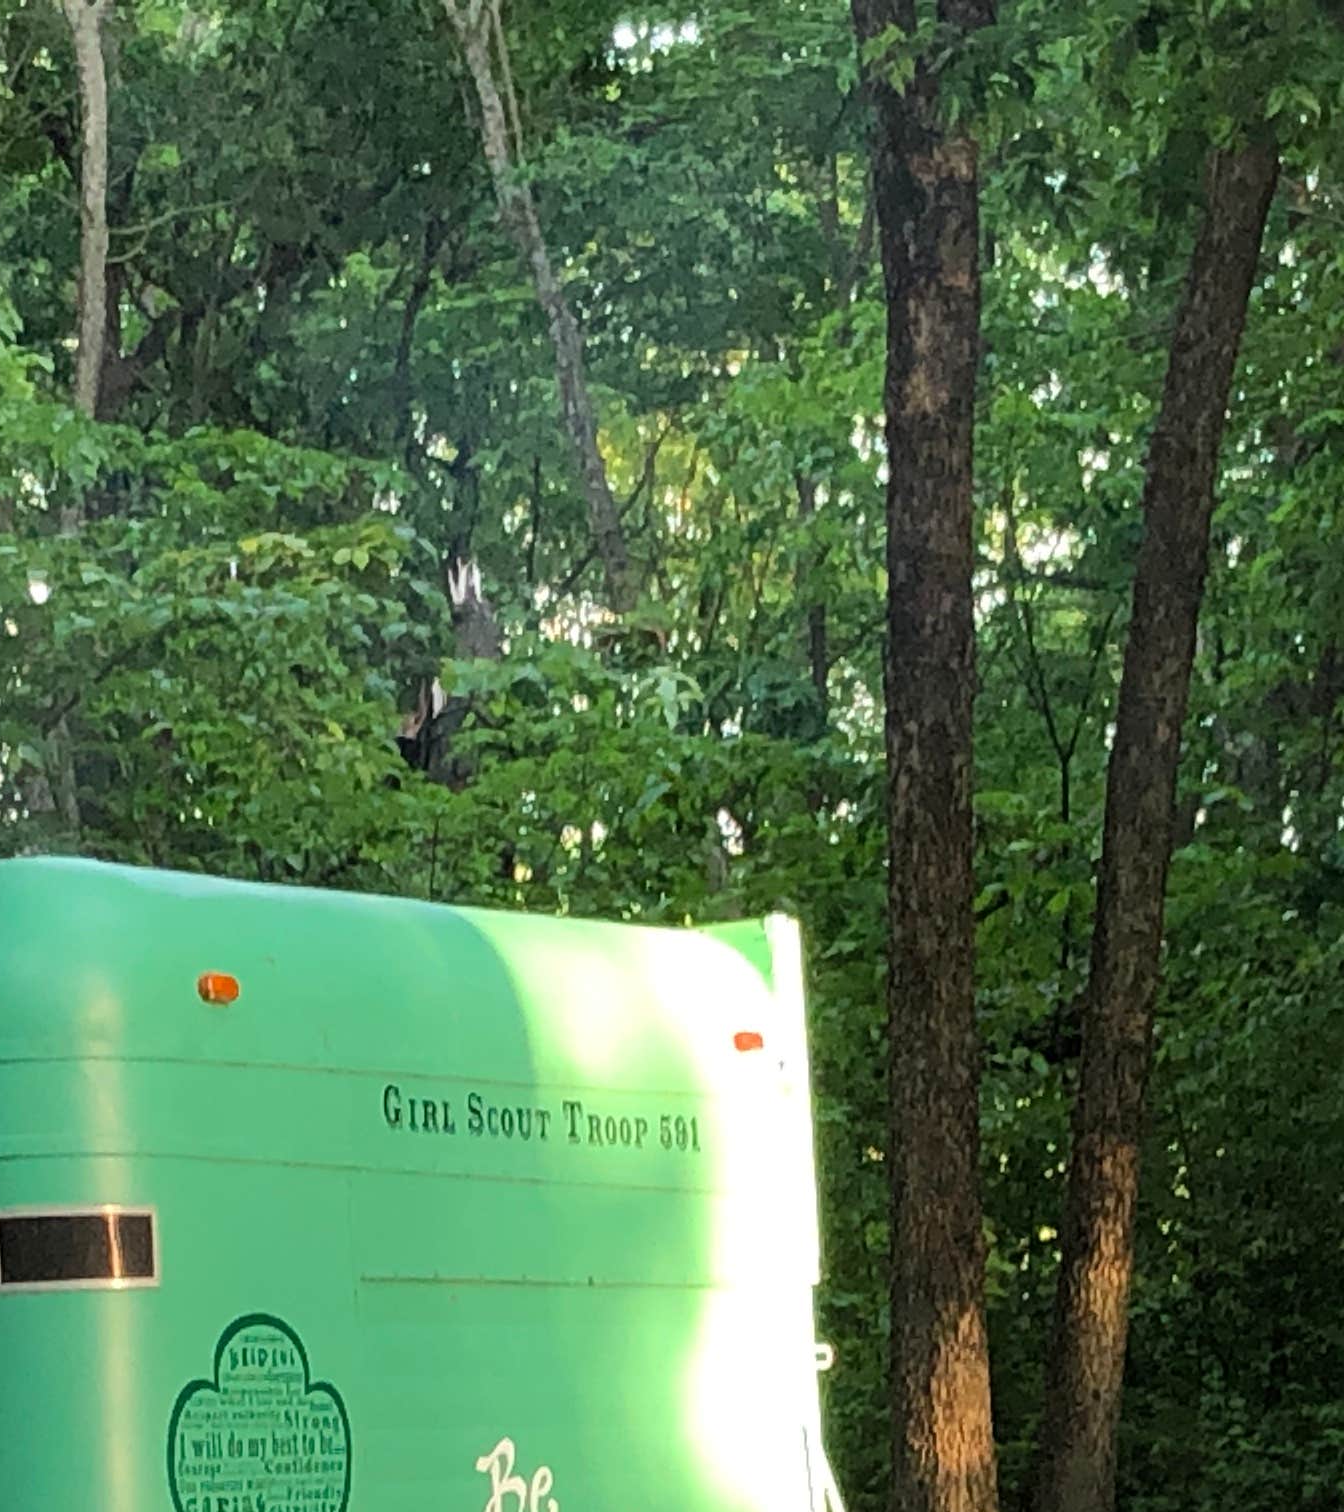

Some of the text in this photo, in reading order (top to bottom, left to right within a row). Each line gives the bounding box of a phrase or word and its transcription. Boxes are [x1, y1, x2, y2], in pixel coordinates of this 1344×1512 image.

[192, 1431, 223, 1454] will
[228, 1429, 244, 1453] do
[248, 1437, 267, 1458] my
[272, 1429, 299, 1453] best
[302, 1430, 316, 1452] to
